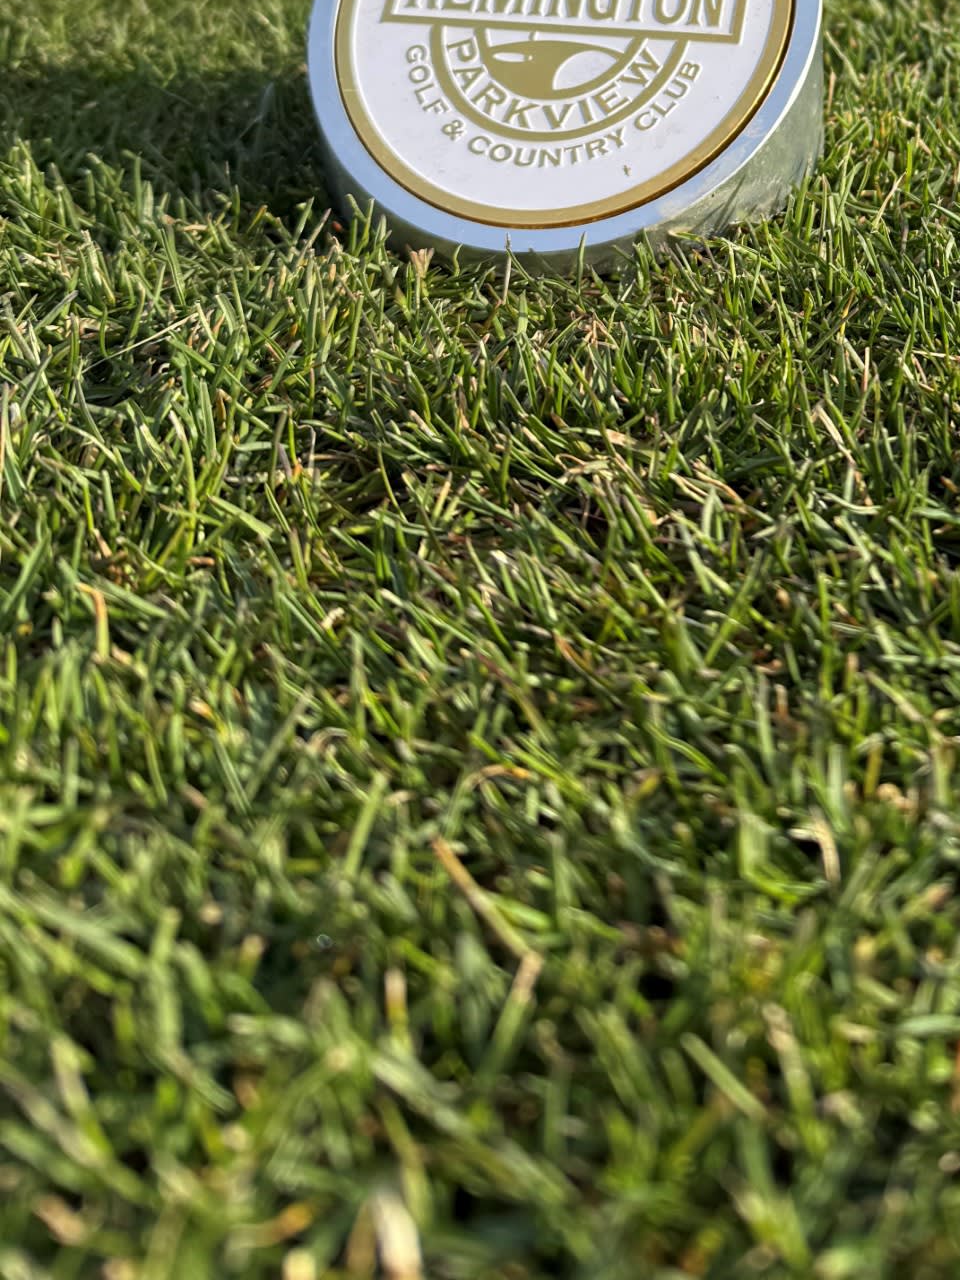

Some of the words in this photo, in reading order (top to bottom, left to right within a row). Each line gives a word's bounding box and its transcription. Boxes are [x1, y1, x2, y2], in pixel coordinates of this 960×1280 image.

[405, 43, 450, 117] GOLF
[441, 118, 464, 142] &
[467, 128, 627, 169] COUNTRY
[633, 61, 702, 132] CLUB
[446, 37, 661, 131] PARKVIEW
